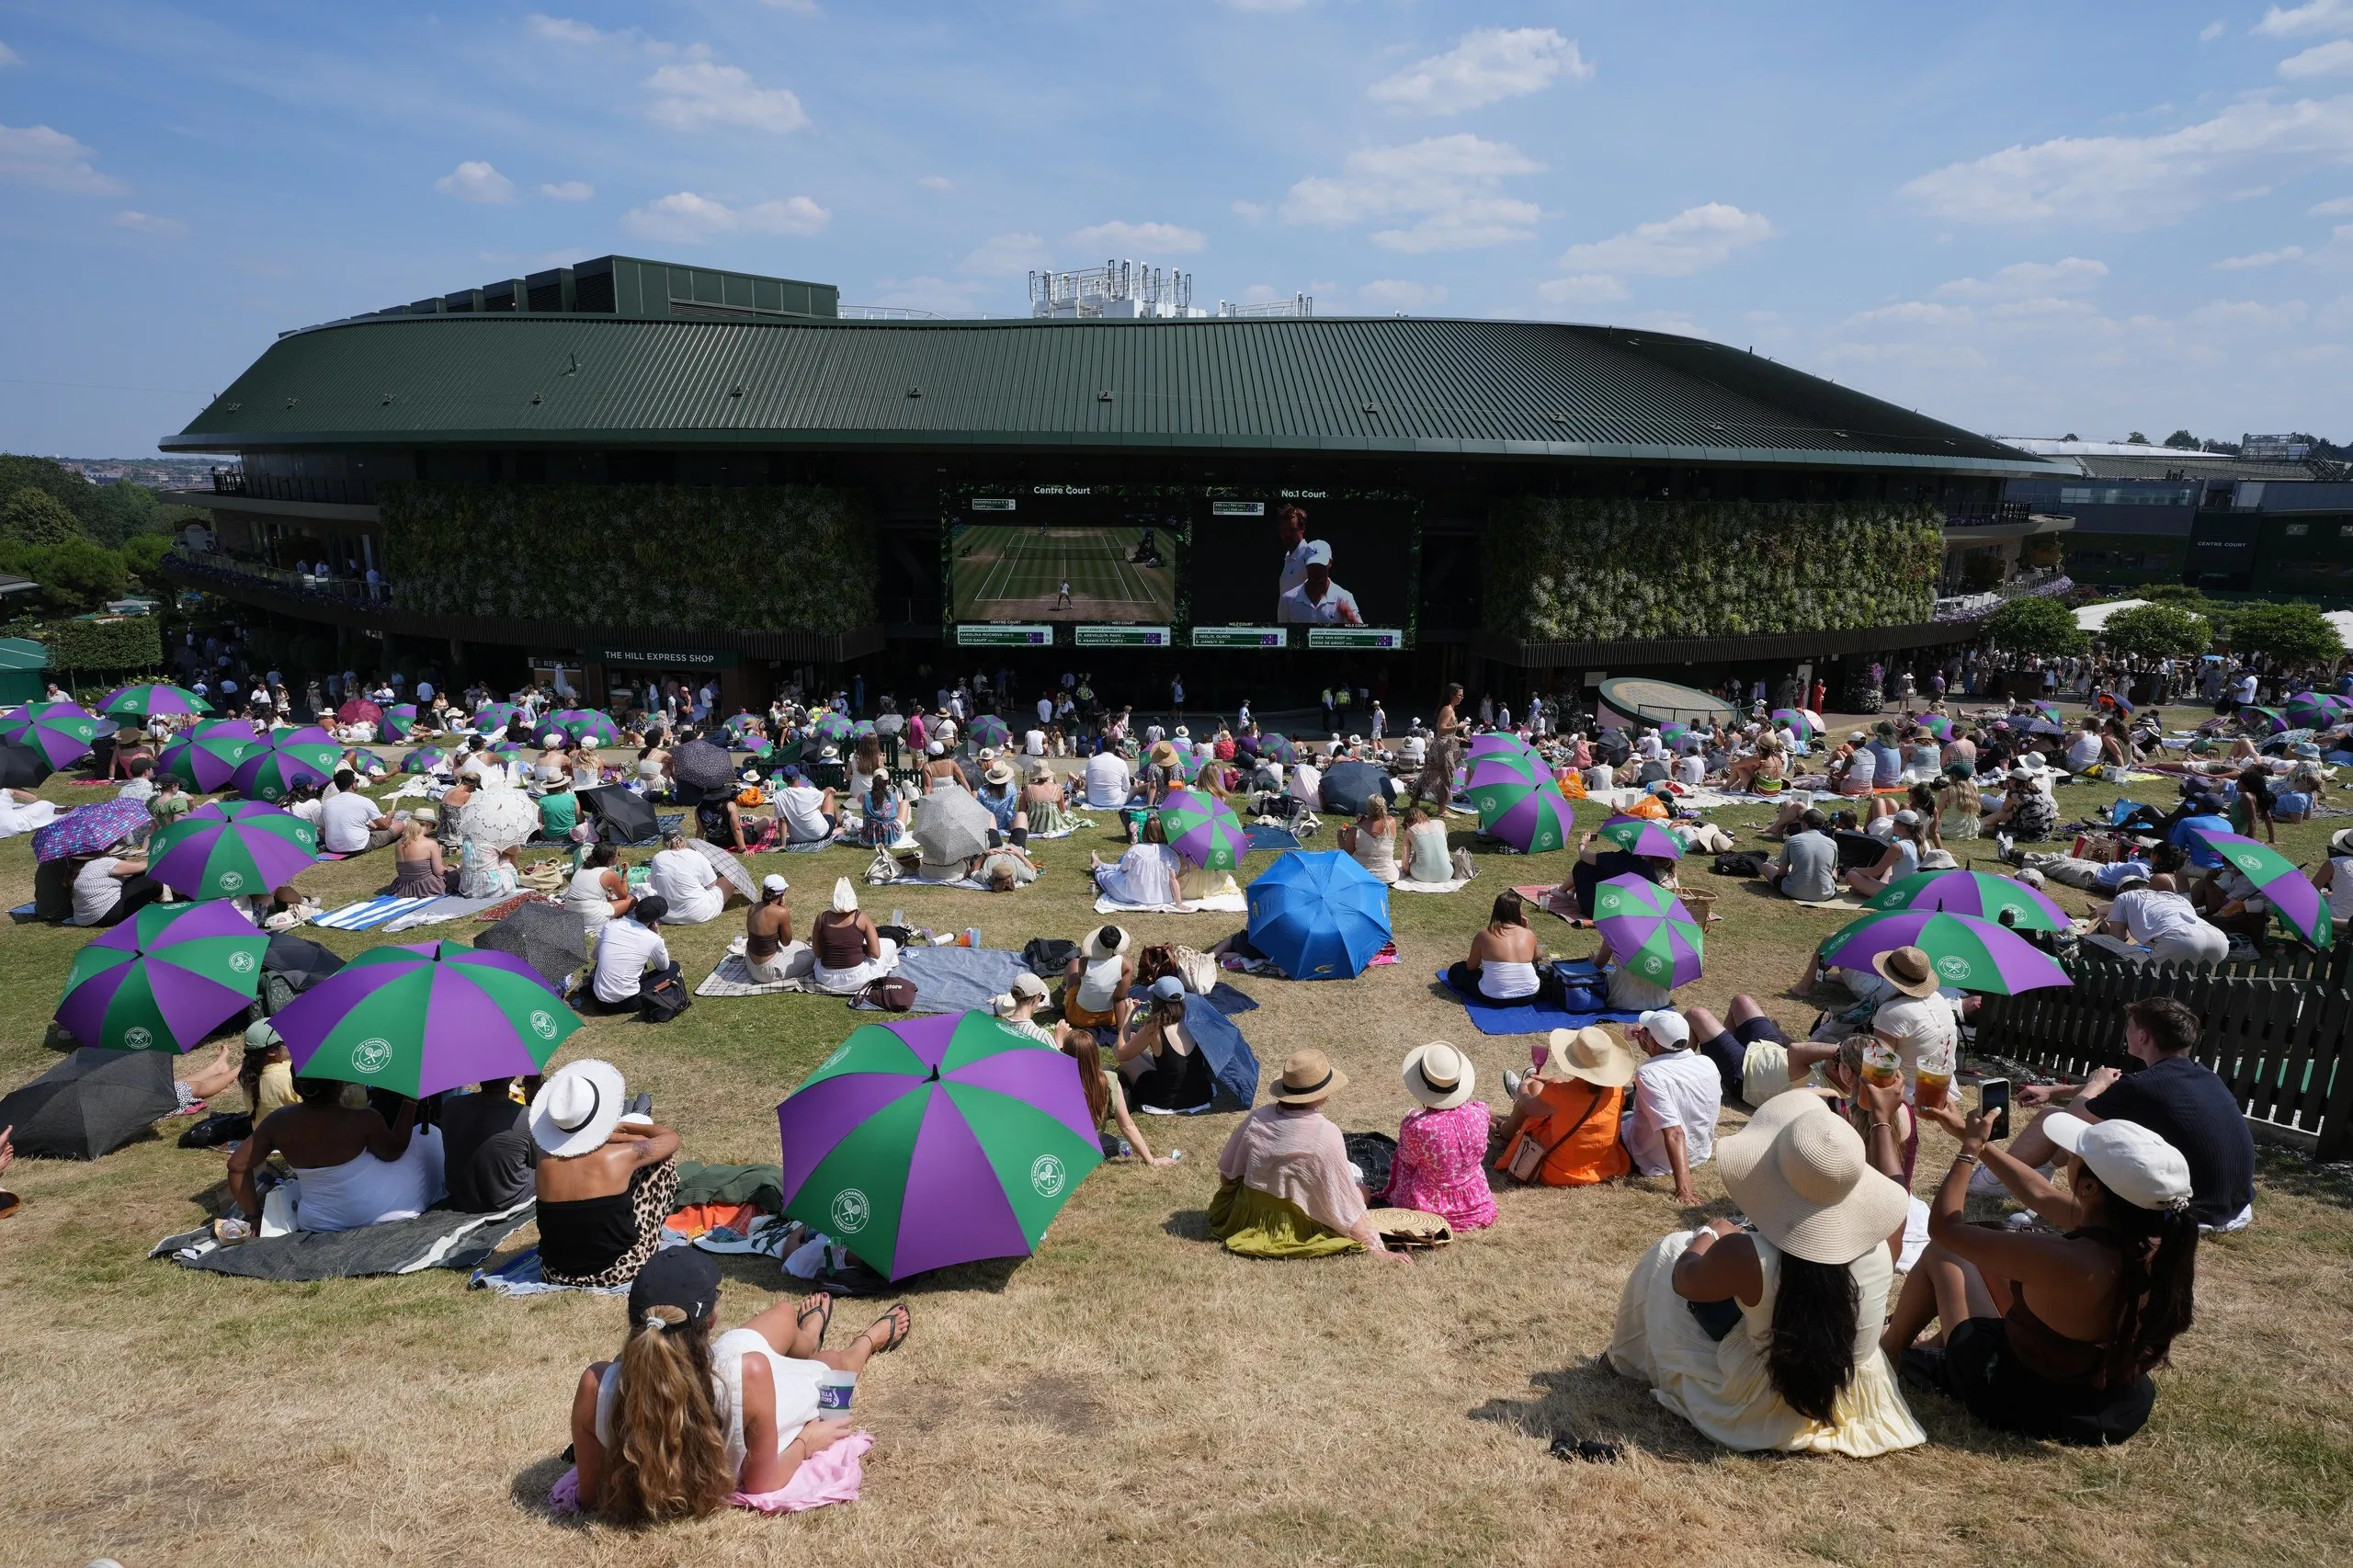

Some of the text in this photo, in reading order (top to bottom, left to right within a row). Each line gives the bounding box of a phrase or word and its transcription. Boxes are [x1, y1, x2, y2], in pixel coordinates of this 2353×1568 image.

[647, 653, 687, 662] EXPRESS
[689, 654, 714, 662] SHOP
[836, 1193, 845, 1202] THE
[834, 1214, 857, 1231] WIMBLEDON
